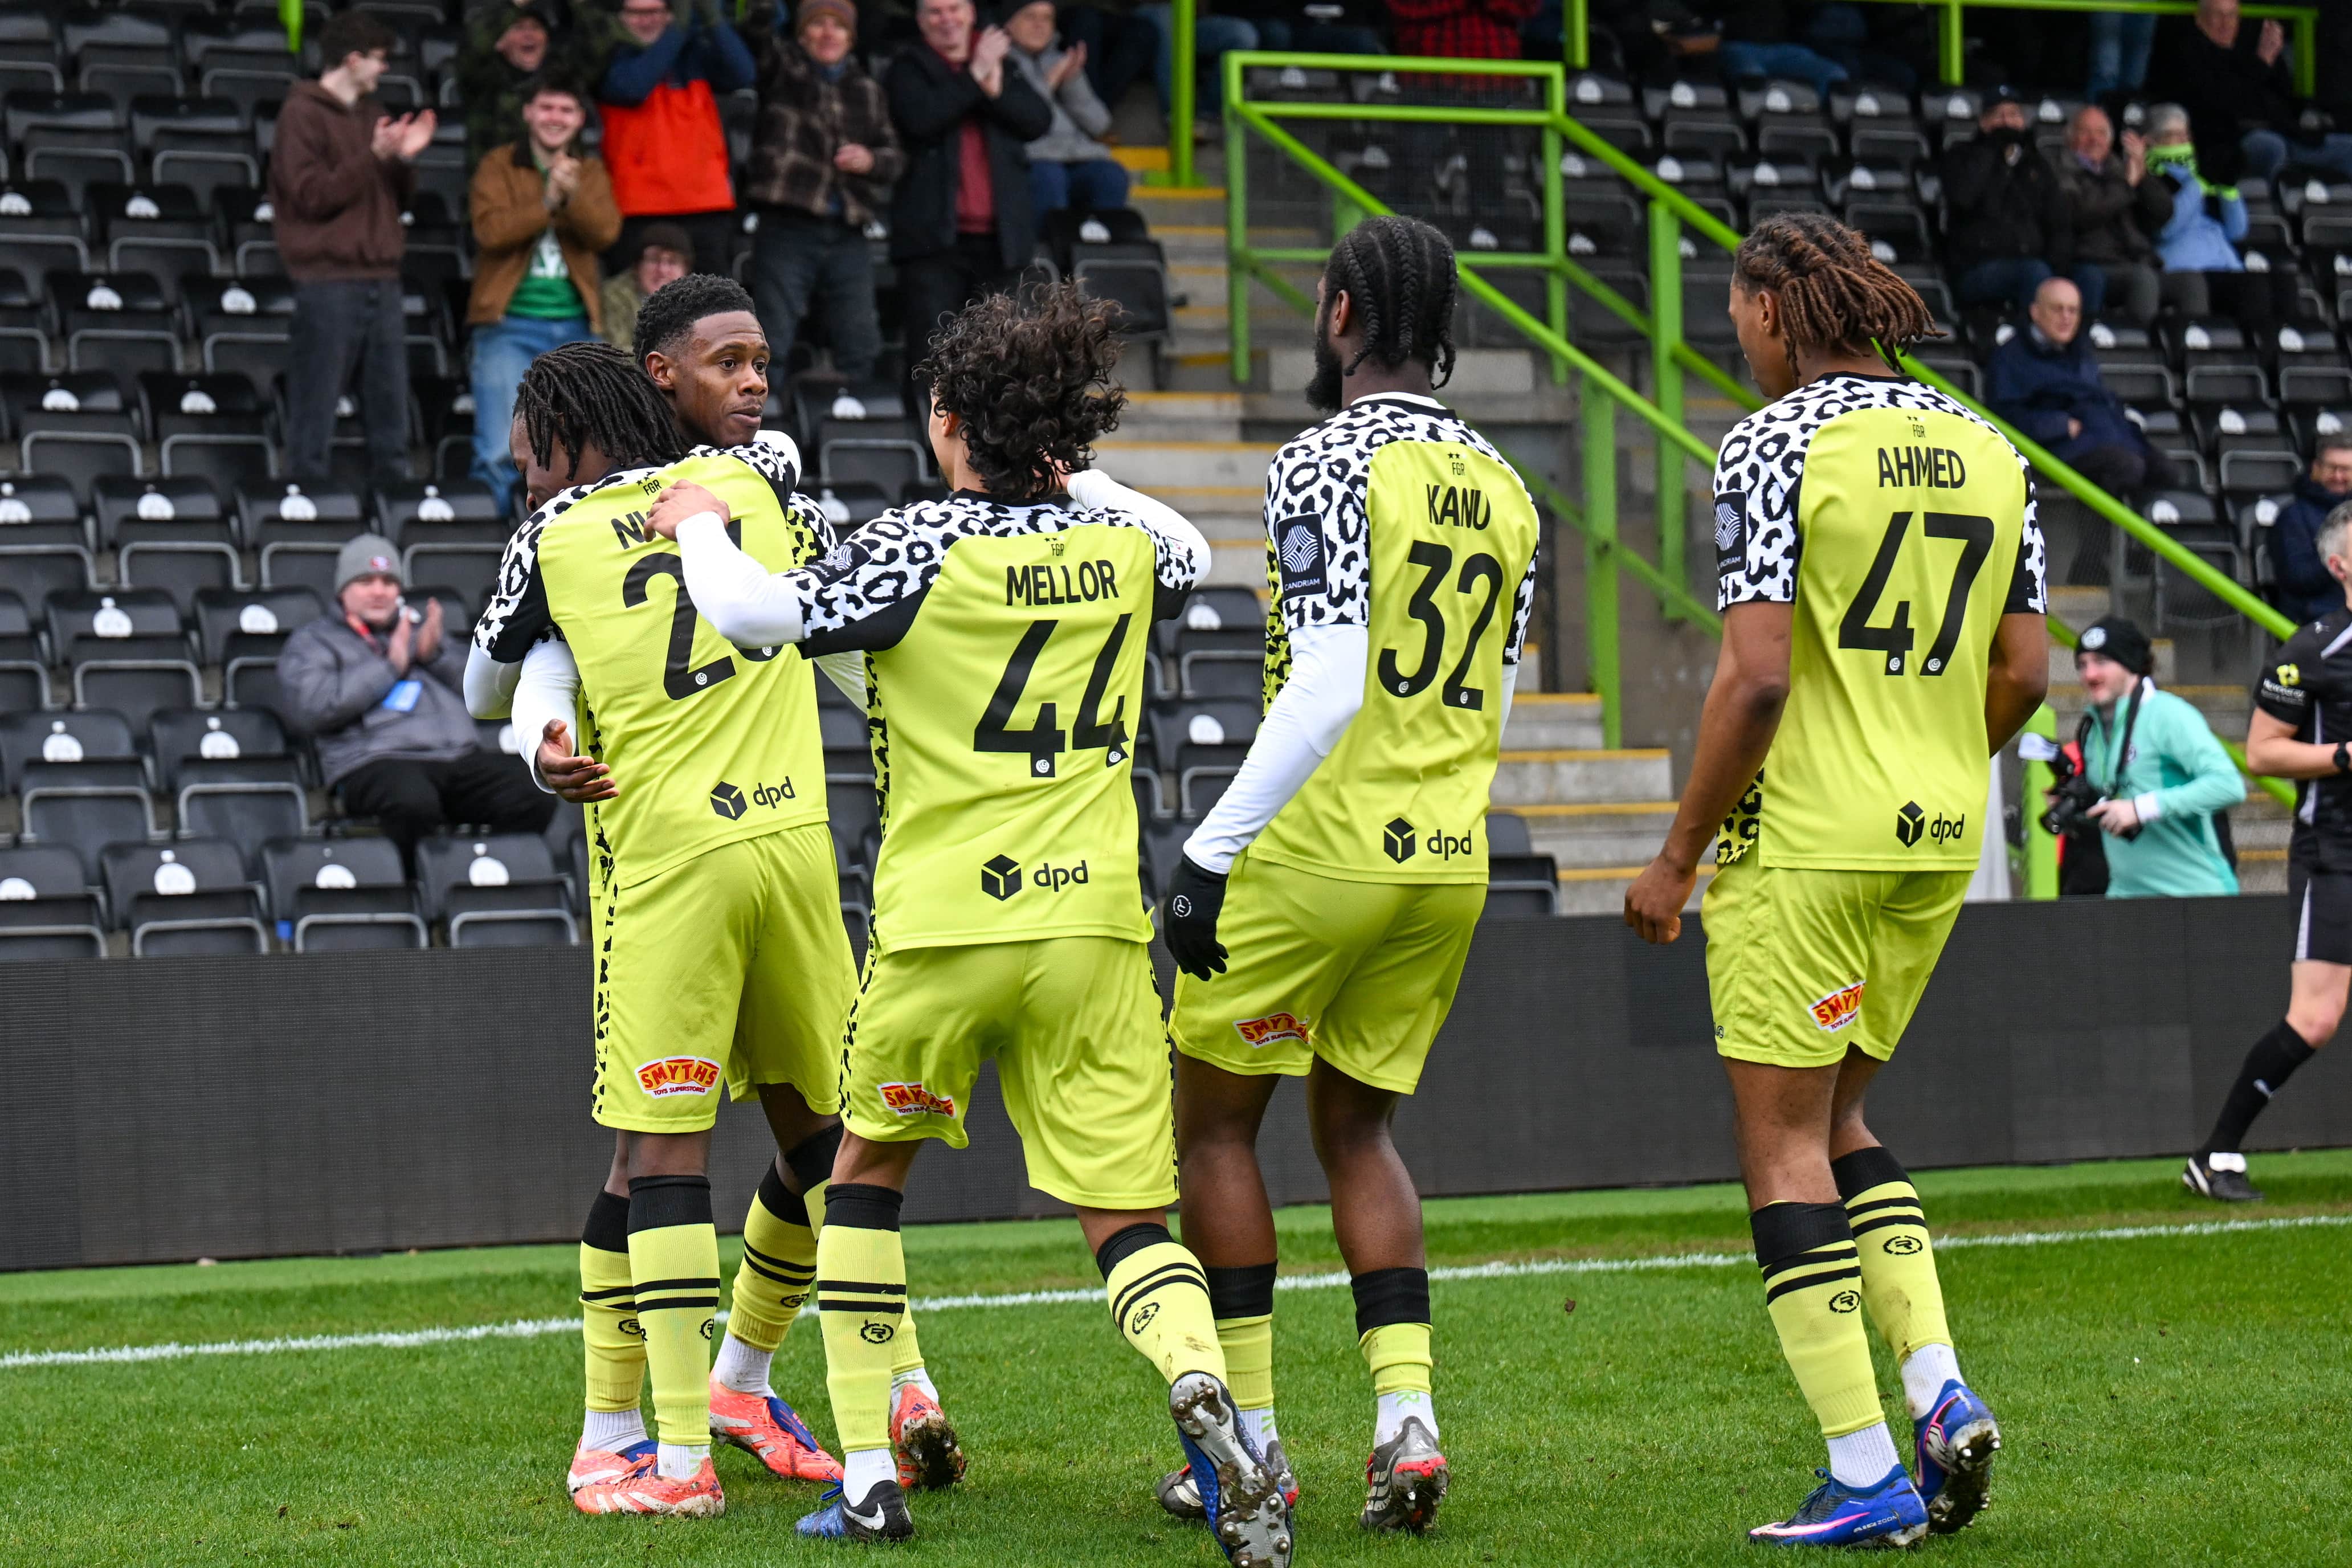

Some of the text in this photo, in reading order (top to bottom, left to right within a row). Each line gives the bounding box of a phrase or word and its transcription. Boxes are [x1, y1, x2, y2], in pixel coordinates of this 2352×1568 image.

[1913, 424, 1925, 438] FGR
[1452, 462, 1465, 476] FGR
[1877, 446, 1966, 489] AHMED
[643, 479, 662, 496] FGR
[1426, 484, 1491, 530] KANU
[1051, 544, 1064, 557] FGR
[1006, 560, 1119, 606] MELLOR
[1284, 578, 1321, 591] CANDRIAM
[1838, 512, 1994, 676] 47
[1378, 540, 1503, 712] 32
[973, 612, 1133, 778] 44
[753, 775, 796, 809] dpd
[1930, 812, 1965, 844] dpd
[1427, 829, 1472, 861] dpd
[1034, 860, 1089, 892] dpd
[641, 1064, 717, 1088] SMYTHS
